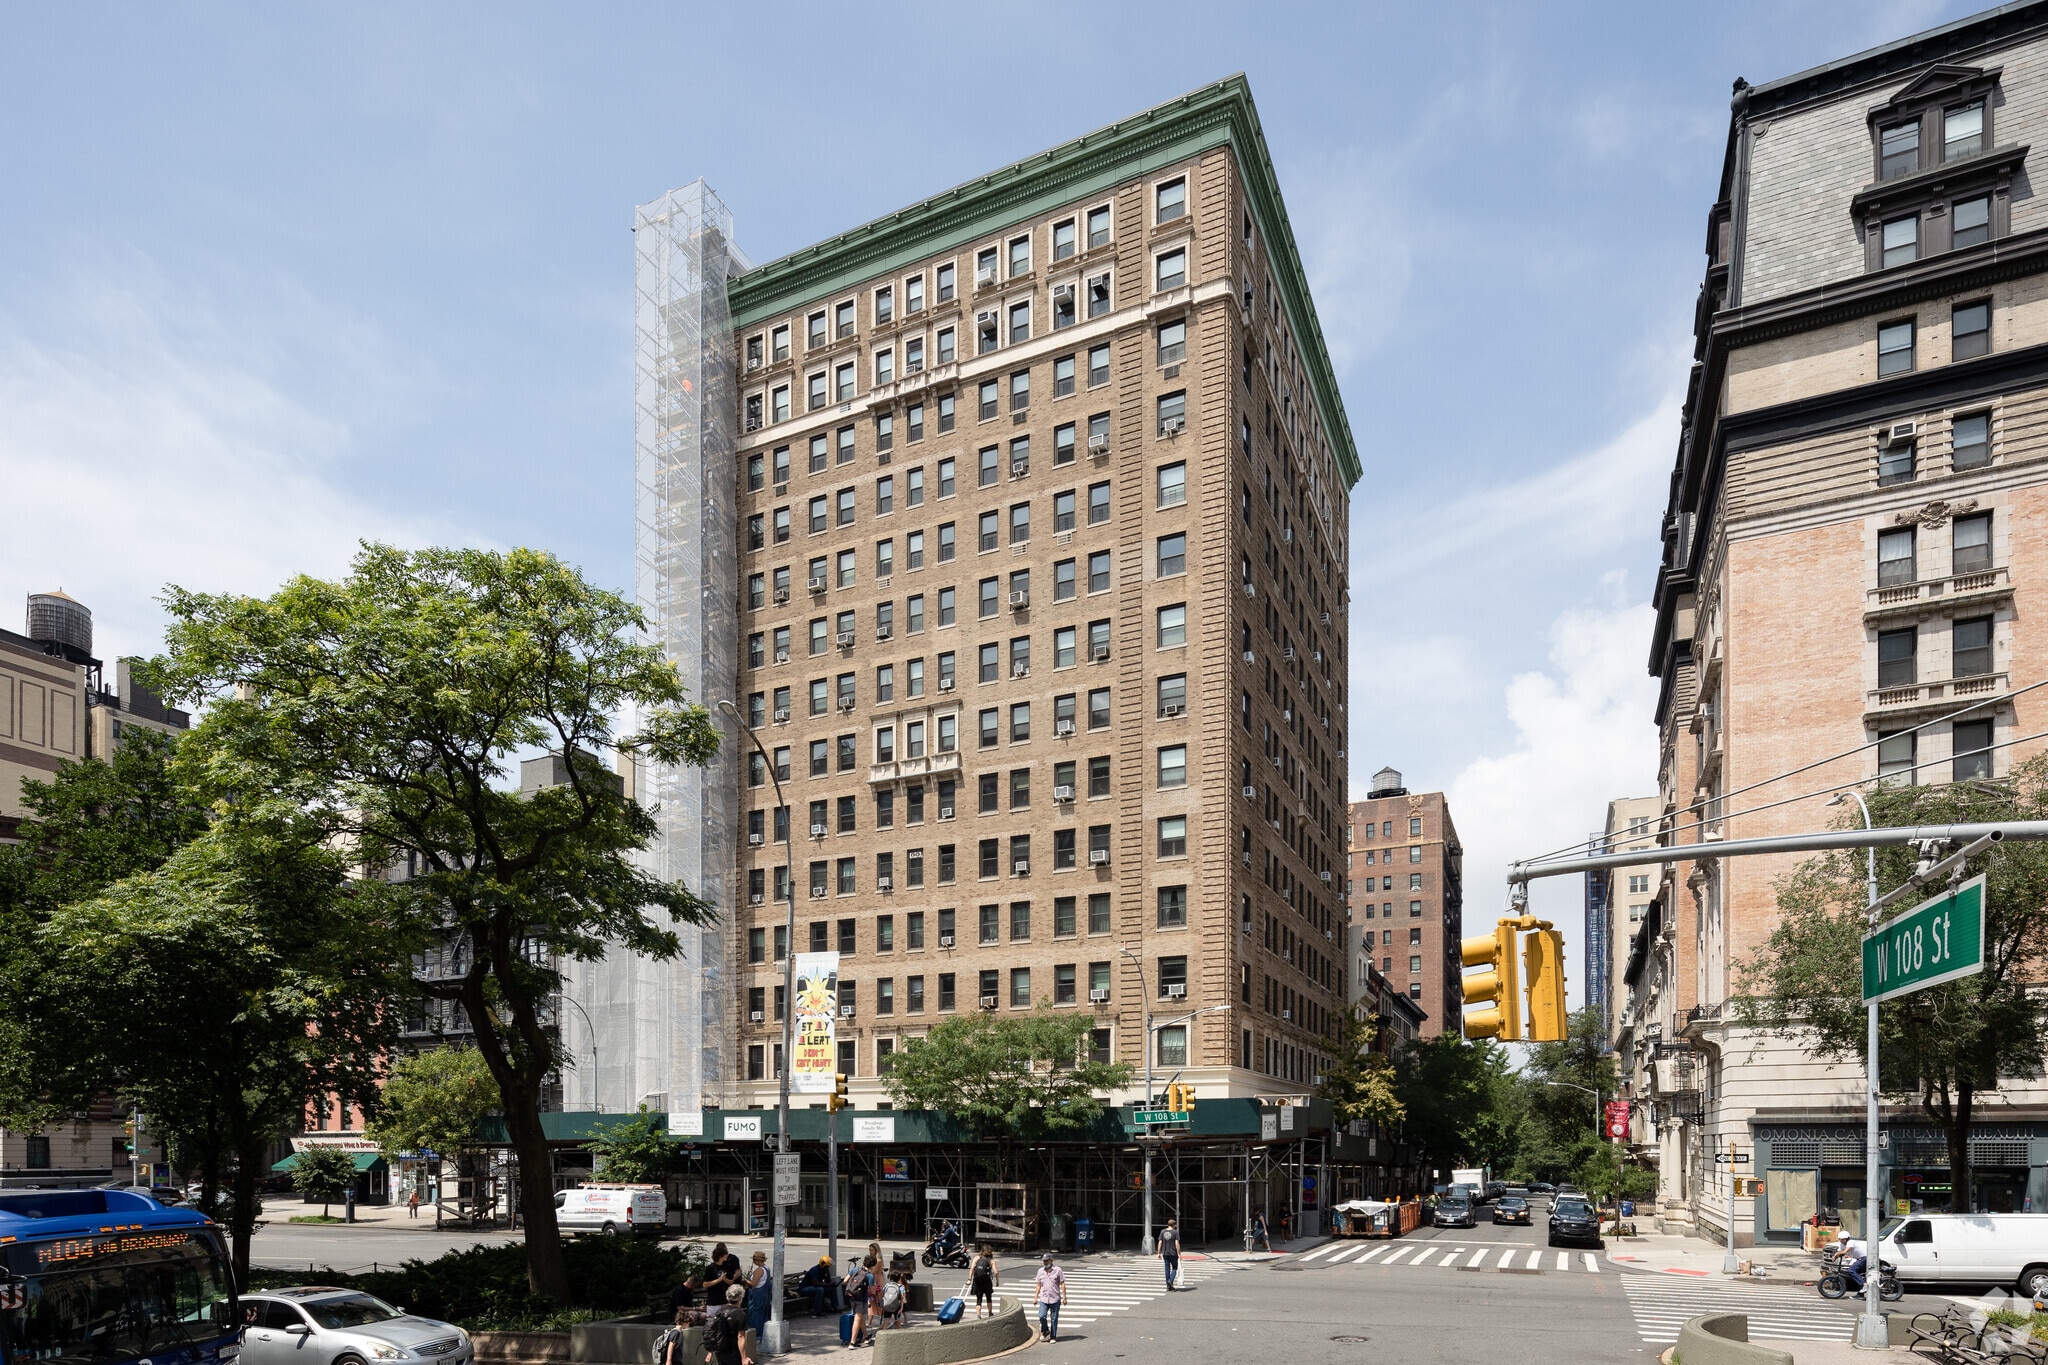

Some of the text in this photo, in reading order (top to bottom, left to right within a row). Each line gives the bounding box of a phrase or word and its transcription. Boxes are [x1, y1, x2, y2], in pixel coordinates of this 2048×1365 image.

[1877, 911, 1951, 984] W 108 St
[803, 1048, 825, 1058] DON'T
[796, 1058, 833, 1068] GET HURT
[1144, 1112, 1179, 1121] W 108 St
[727, 1122, 757, 1132] FUMO
[1759, 1128, 1868, 1142] OMONIA CAF
[1971, 1127, 2037, 1140] HEALTH
[776, 1157, 799, 1166] LEFT LANE
[775, 1166, 799, 1175] MUST YIELD
[784, 1175, 790, 1183] TO
[777, 1184, 797, 1193] ONCOMING
[778, 1193, 796, 1201] TRAFFIC
[38, 1238, 94, 1263] M104
[121, 1233, 189, 1251] BROADWAY
